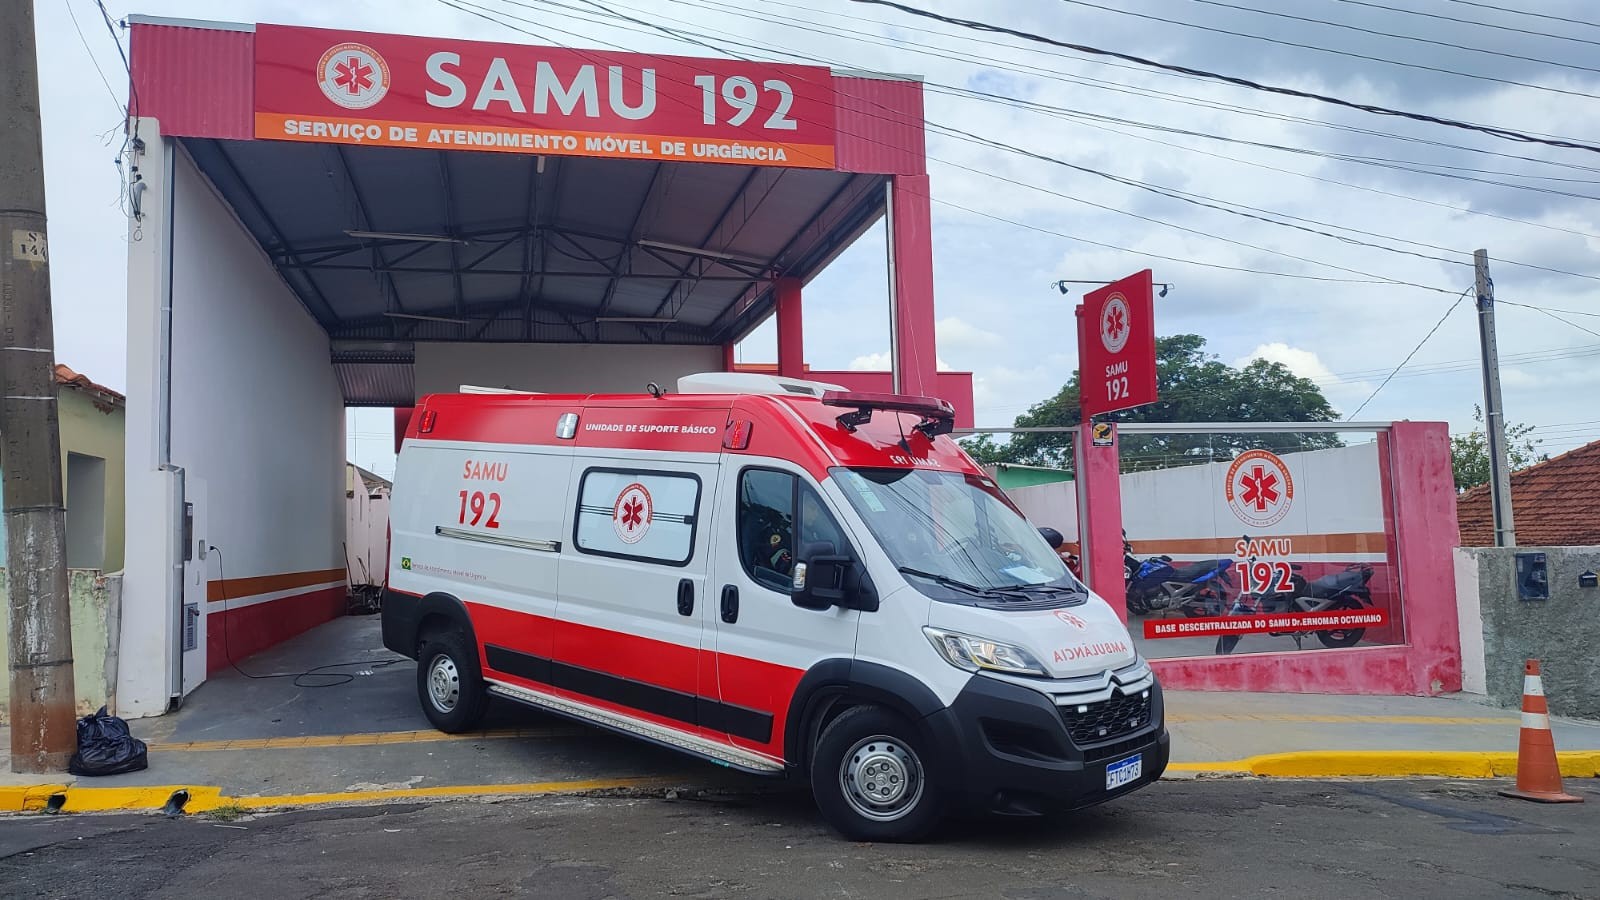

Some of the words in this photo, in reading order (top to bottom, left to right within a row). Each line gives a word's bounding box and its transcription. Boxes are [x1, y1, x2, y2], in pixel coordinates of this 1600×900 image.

[424, 50, 658, 121] SAMU
[693, 74, 798, 131] 192
[284, 119, 382, 142] SERVIÇO
[389, 126, 418, 142] DE
[427, 128, 578, 151] ATENDIMENTO
[585, 135, 653, 154] MÓVEL
[660, 141, 686, 156] DE
[692, 143, 787, 162] URGÊNCIA
[1105, 360, 1128, 378] SAMU
[1105, 376, 1130, 401] 192
[585, 423, 624, 432] UNIDADE
[625, 424, 638, 432] DE
[639, 425, 679, 433] SUPORTE
[681, 423, 717, 434] BÁSICO
[463, 459, 509, 482] SAMU
[459, 490, 501, 528] 192
[1235, 539, 1292, 558] SAMU
[1235, 561, 1295, 595] 192
[1155, 624, 1176, 634] BASE
[1179, 621, 1252, 632] DESCENTRALIZADA
[1254, 620, 1266, 629] DO
[1268, 618, 1290, 628] SAMU
[1340, 614, 1382, 625] OCTAVIANO
